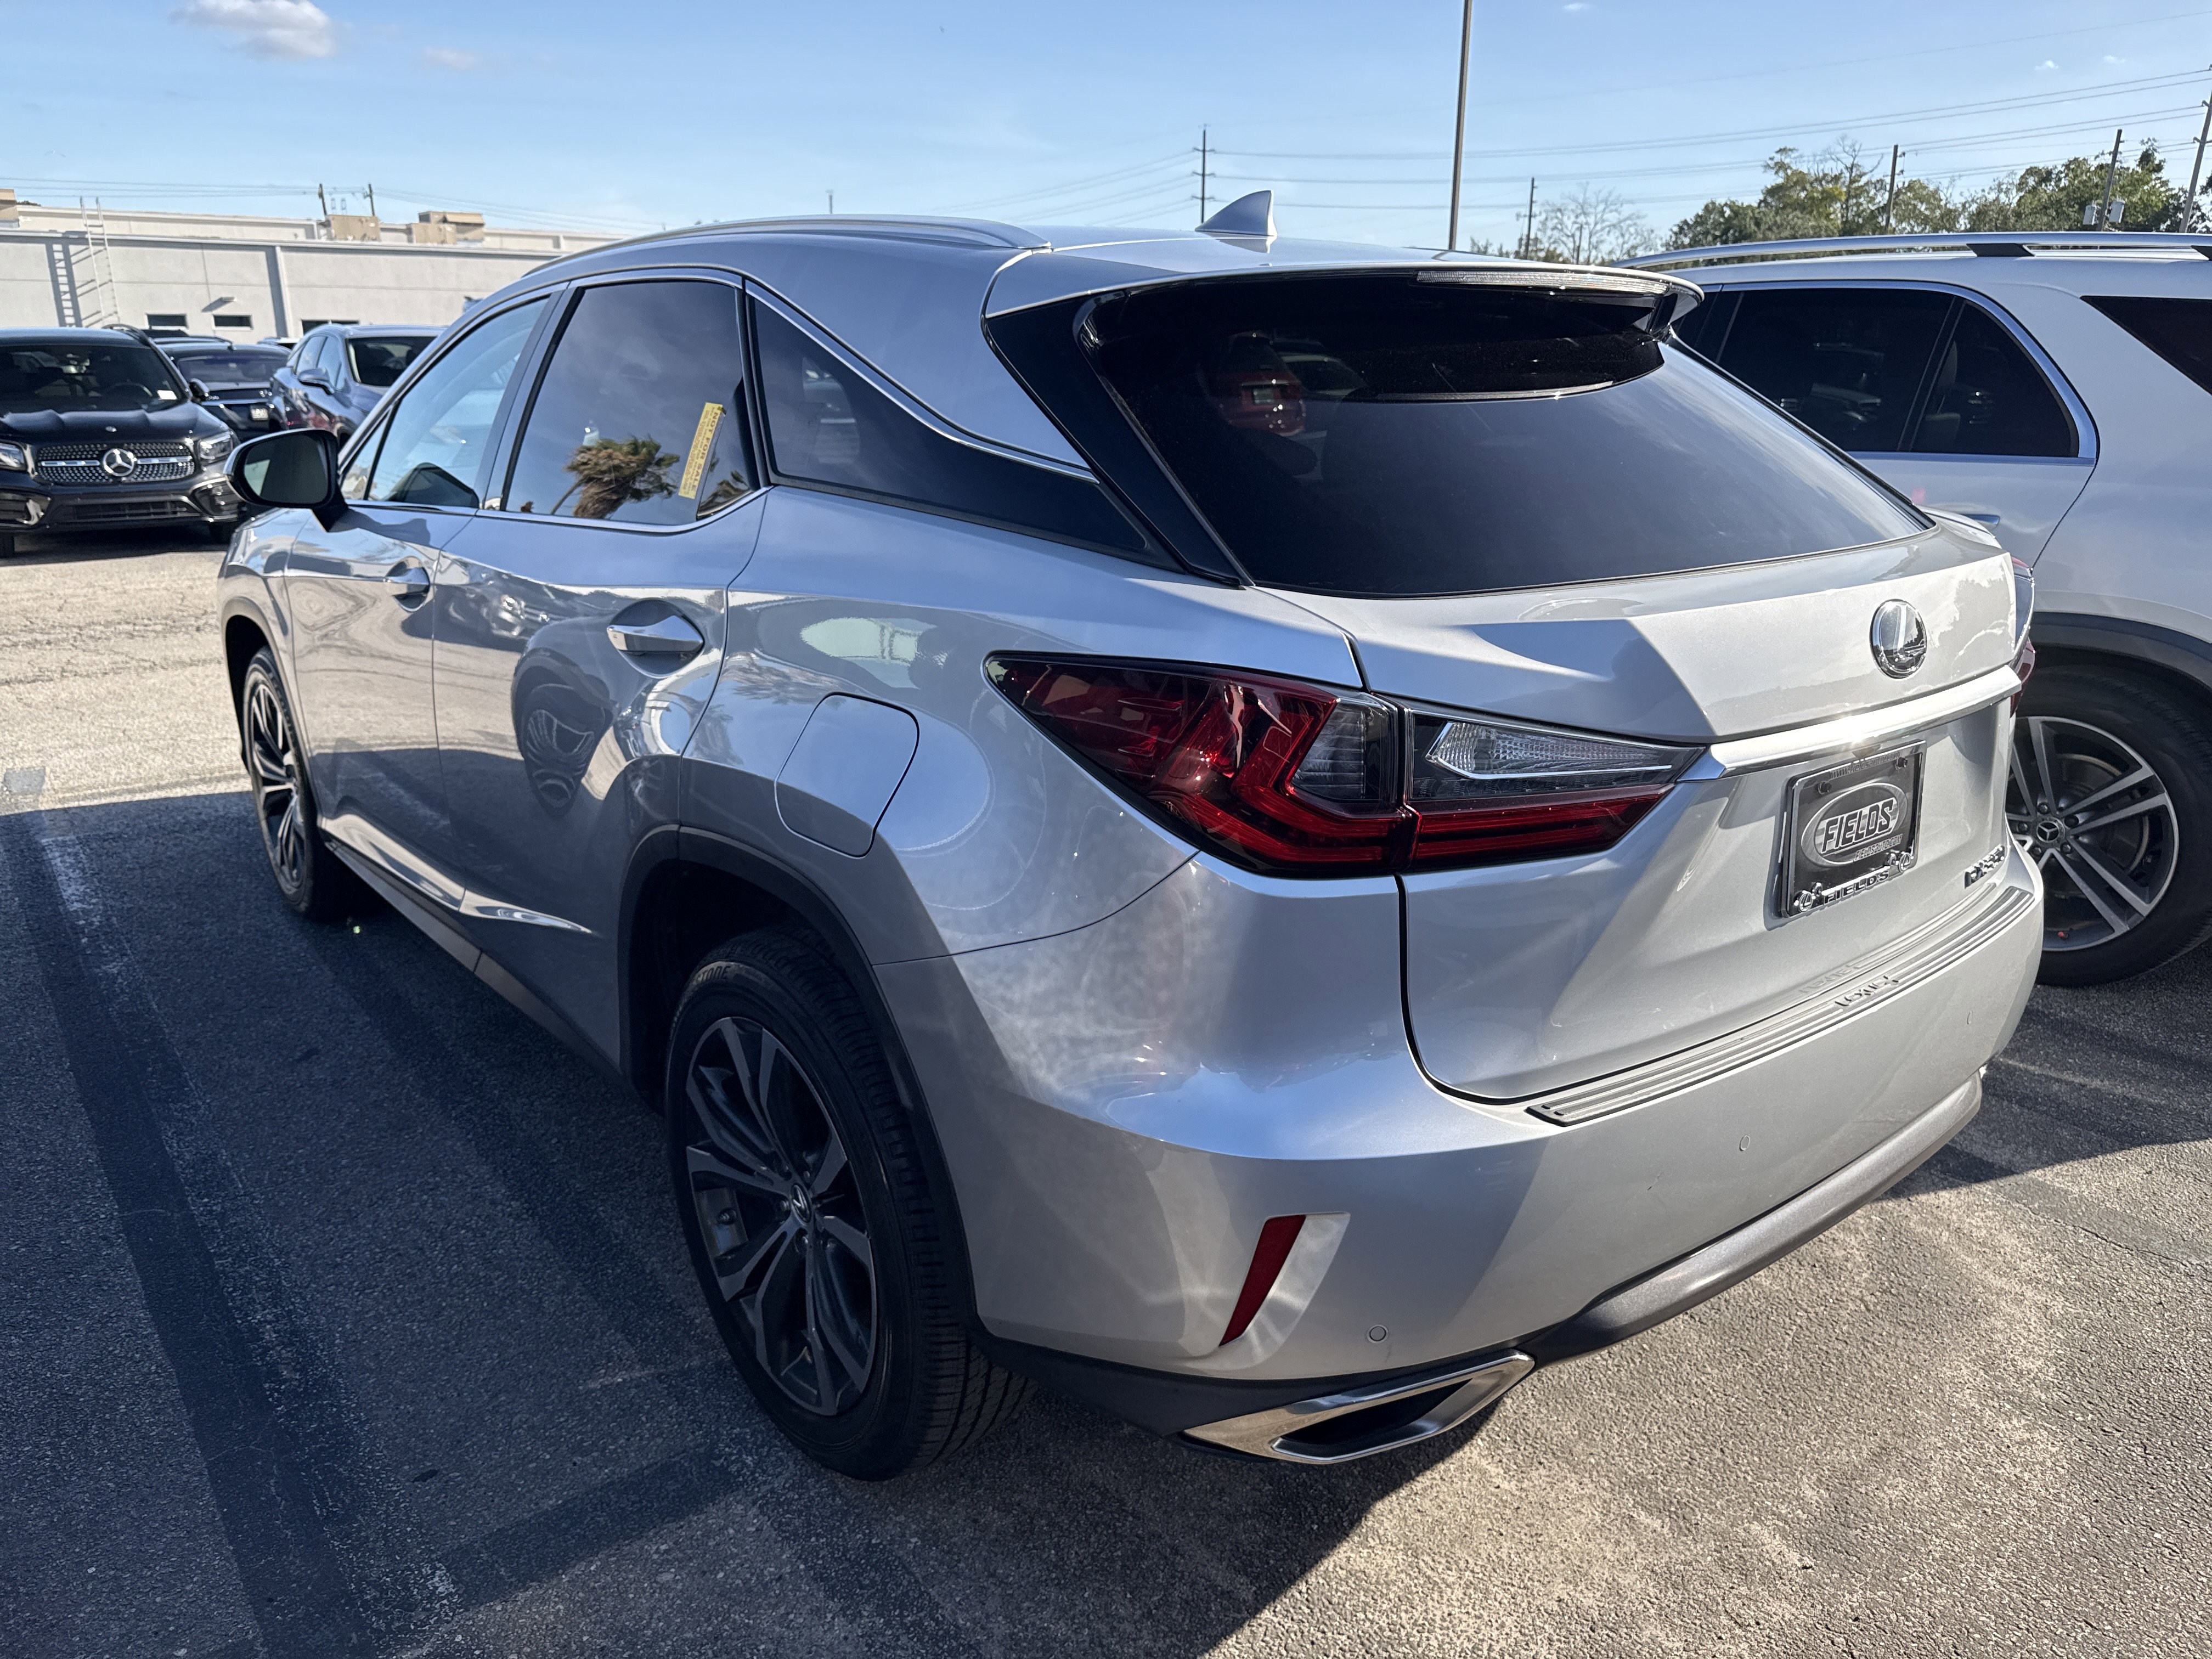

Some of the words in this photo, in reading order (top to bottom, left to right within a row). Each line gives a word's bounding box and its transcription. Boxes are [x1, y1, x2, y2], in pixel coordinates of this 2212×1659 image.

[708, 412, 719, 435] NOT
[700, 437, 710, 460] FOR
[691, 463, 702, 492] SALE
[1821, 799, 1894, 854] FIELDS
[1824, 870, 1889, 905] FIELDS
